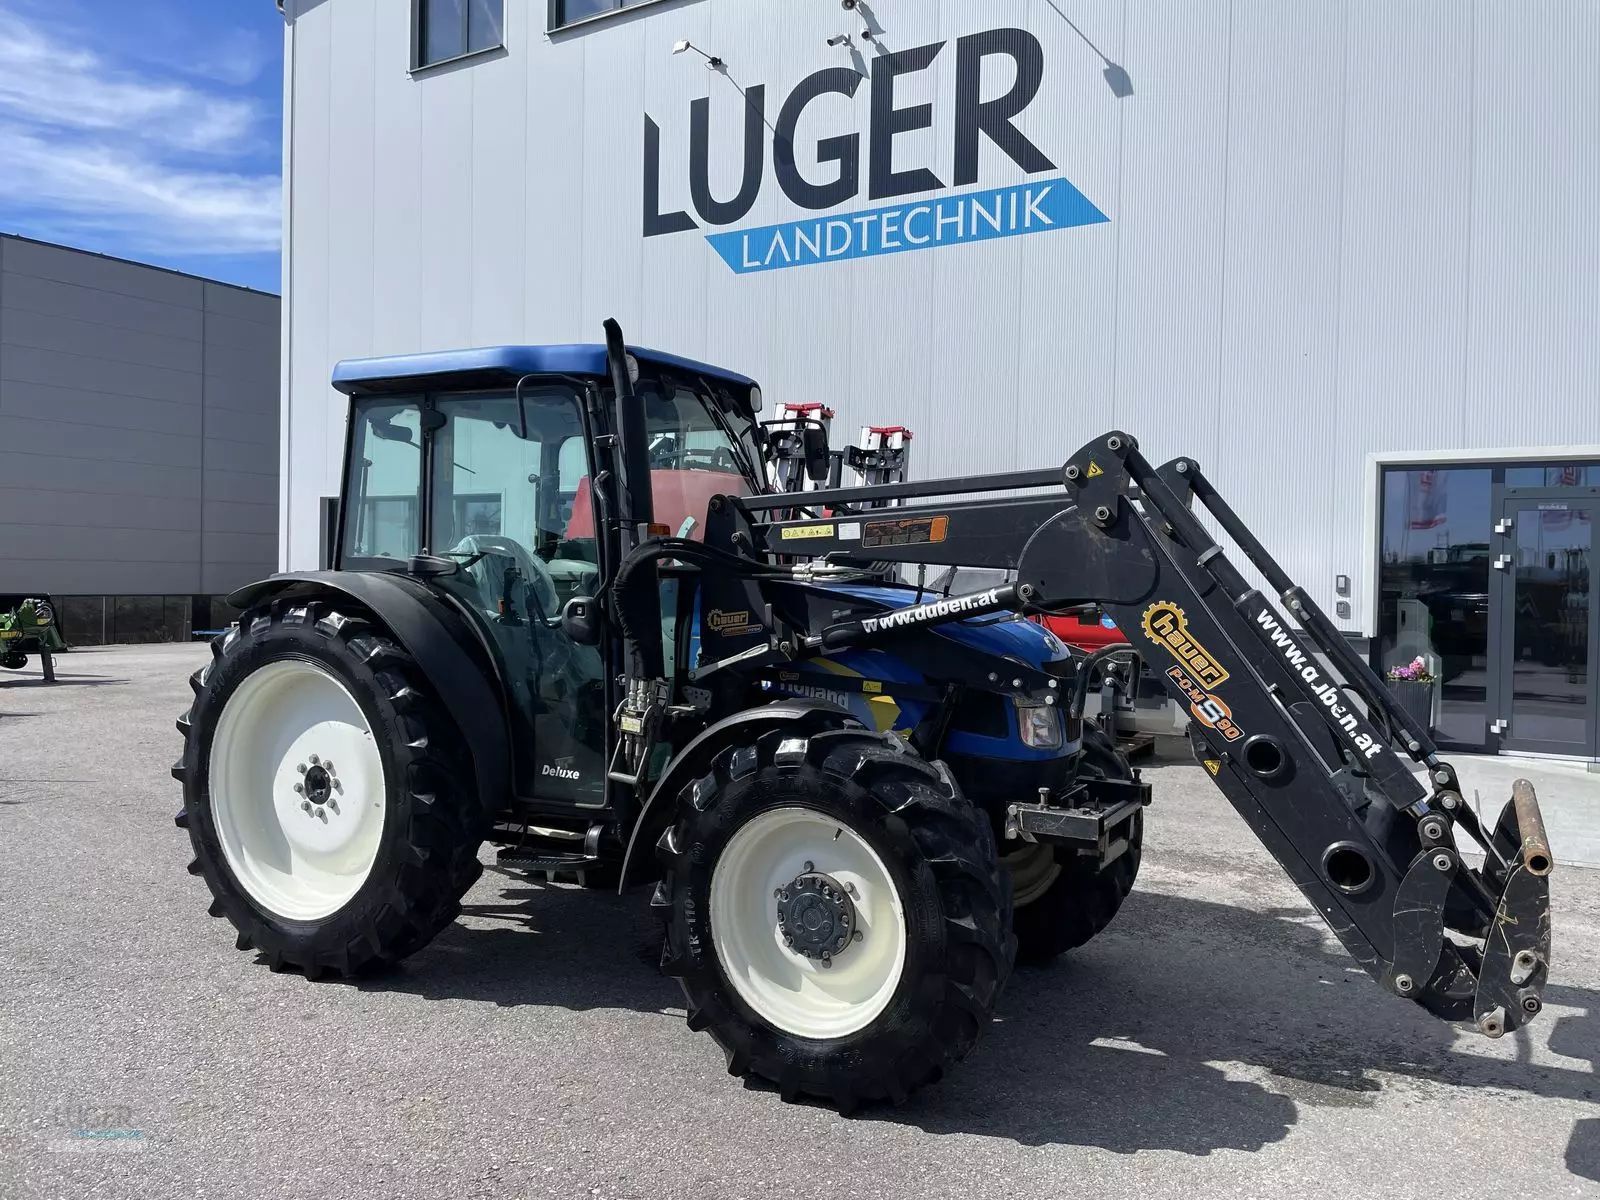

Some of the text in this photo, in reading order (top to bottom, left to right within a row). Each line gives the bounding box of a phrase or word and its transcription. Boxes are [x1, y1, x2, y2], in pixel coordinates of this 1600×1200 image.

[643, 28, 1058, 237] LUGER
[743, 185, 1055, 268] LANDTECHNIK
[1153, 613, 1220, 678] hauer
[541, 764, 580, 780] Deluxe
